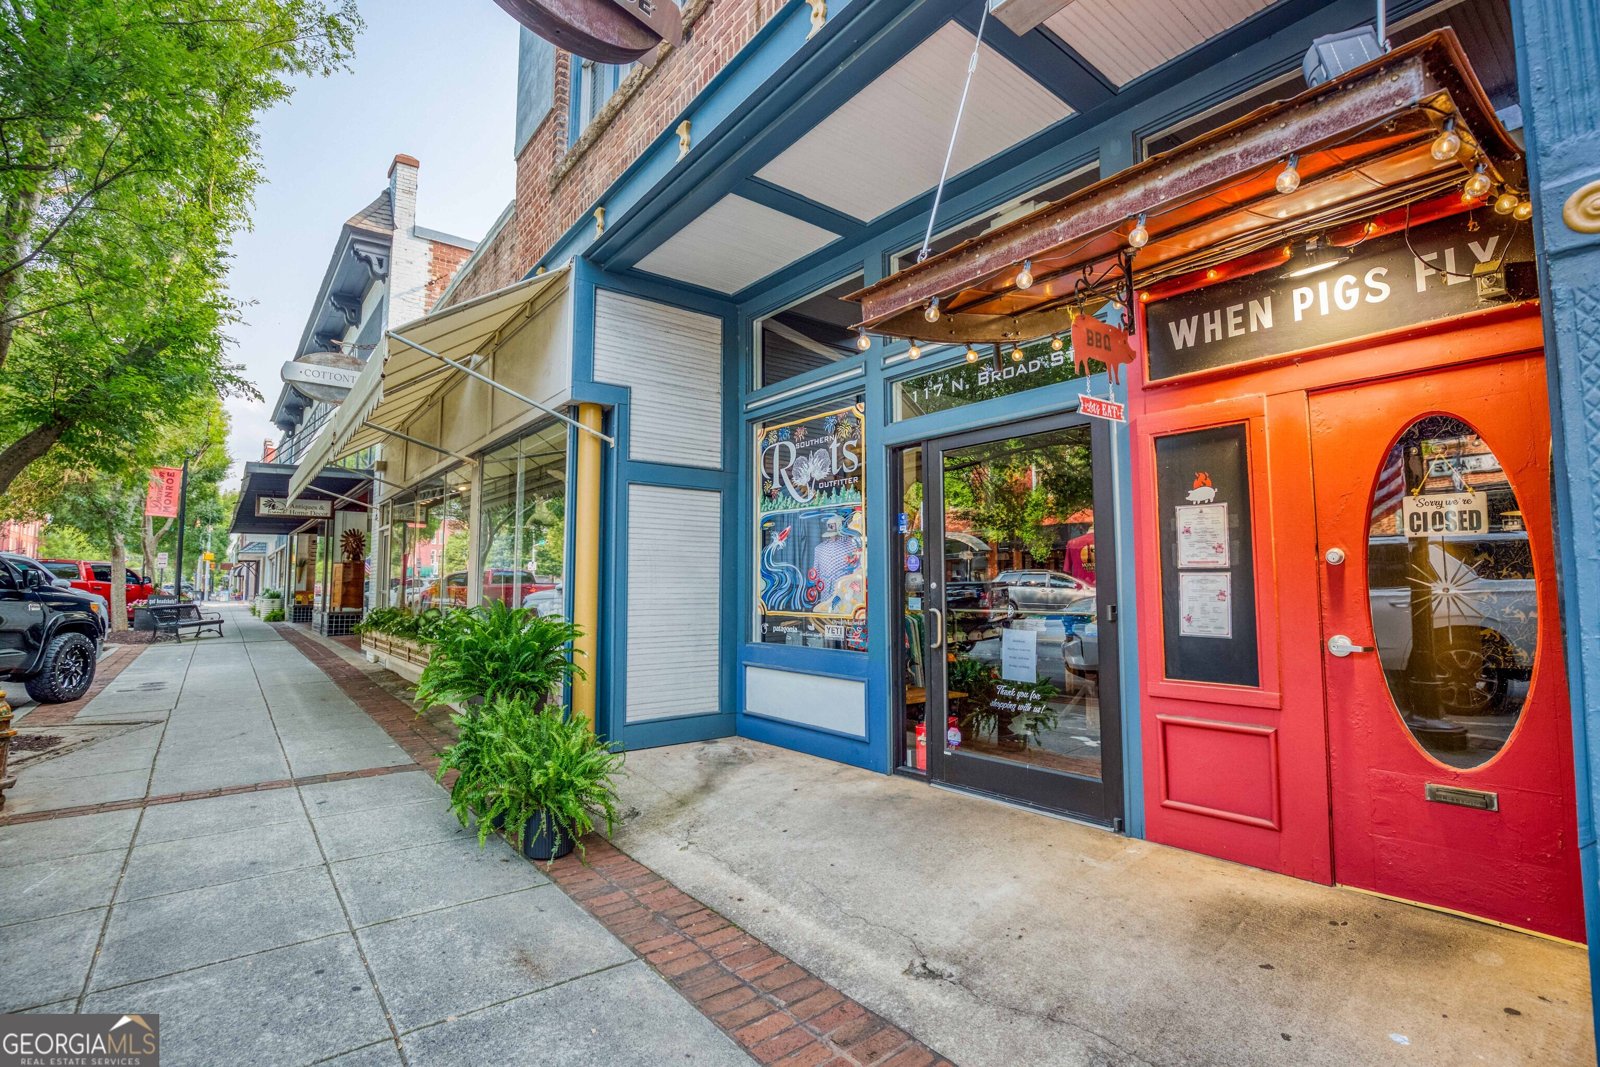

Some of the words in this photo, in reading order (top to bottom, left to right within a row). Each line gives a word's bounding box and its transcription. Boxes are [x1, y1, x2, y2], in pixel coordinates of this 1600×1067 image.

[1168, 296, 1274, 351] WHEN
[1292, 266, 1392, 322] PIGS
[1414, 235, 1500, 294] FLY
[1086, 328, 1112, 352] BBQ
[911, 382, 944, 404] 117
[951, 377, 970, 393] N.
[977, 359, 1041, 386] BROAD
[1101, 403, 1118, 419] EAT
[795, 434, 836, 450] SOUTHERN
[818, 475, 859, 489] OUTFITTER
[163, 471, 176, 513] MONROE
[1415, 497, 1445, 510] Sorry
[1409, 509, 1482, 533] CLOSED
[772, 625, 798, 634] patagonia
[826, 625, 843, 635] YETI
[996, 684, 1016, 697] Thank
[1016, 690, 1030, 700] you
[1029, 690, 1042, 701] for
[990, 699, 1017, 712] shopping
[1017, 702, 1032, 712] with
[1032, 704, 1046, 714] us!
